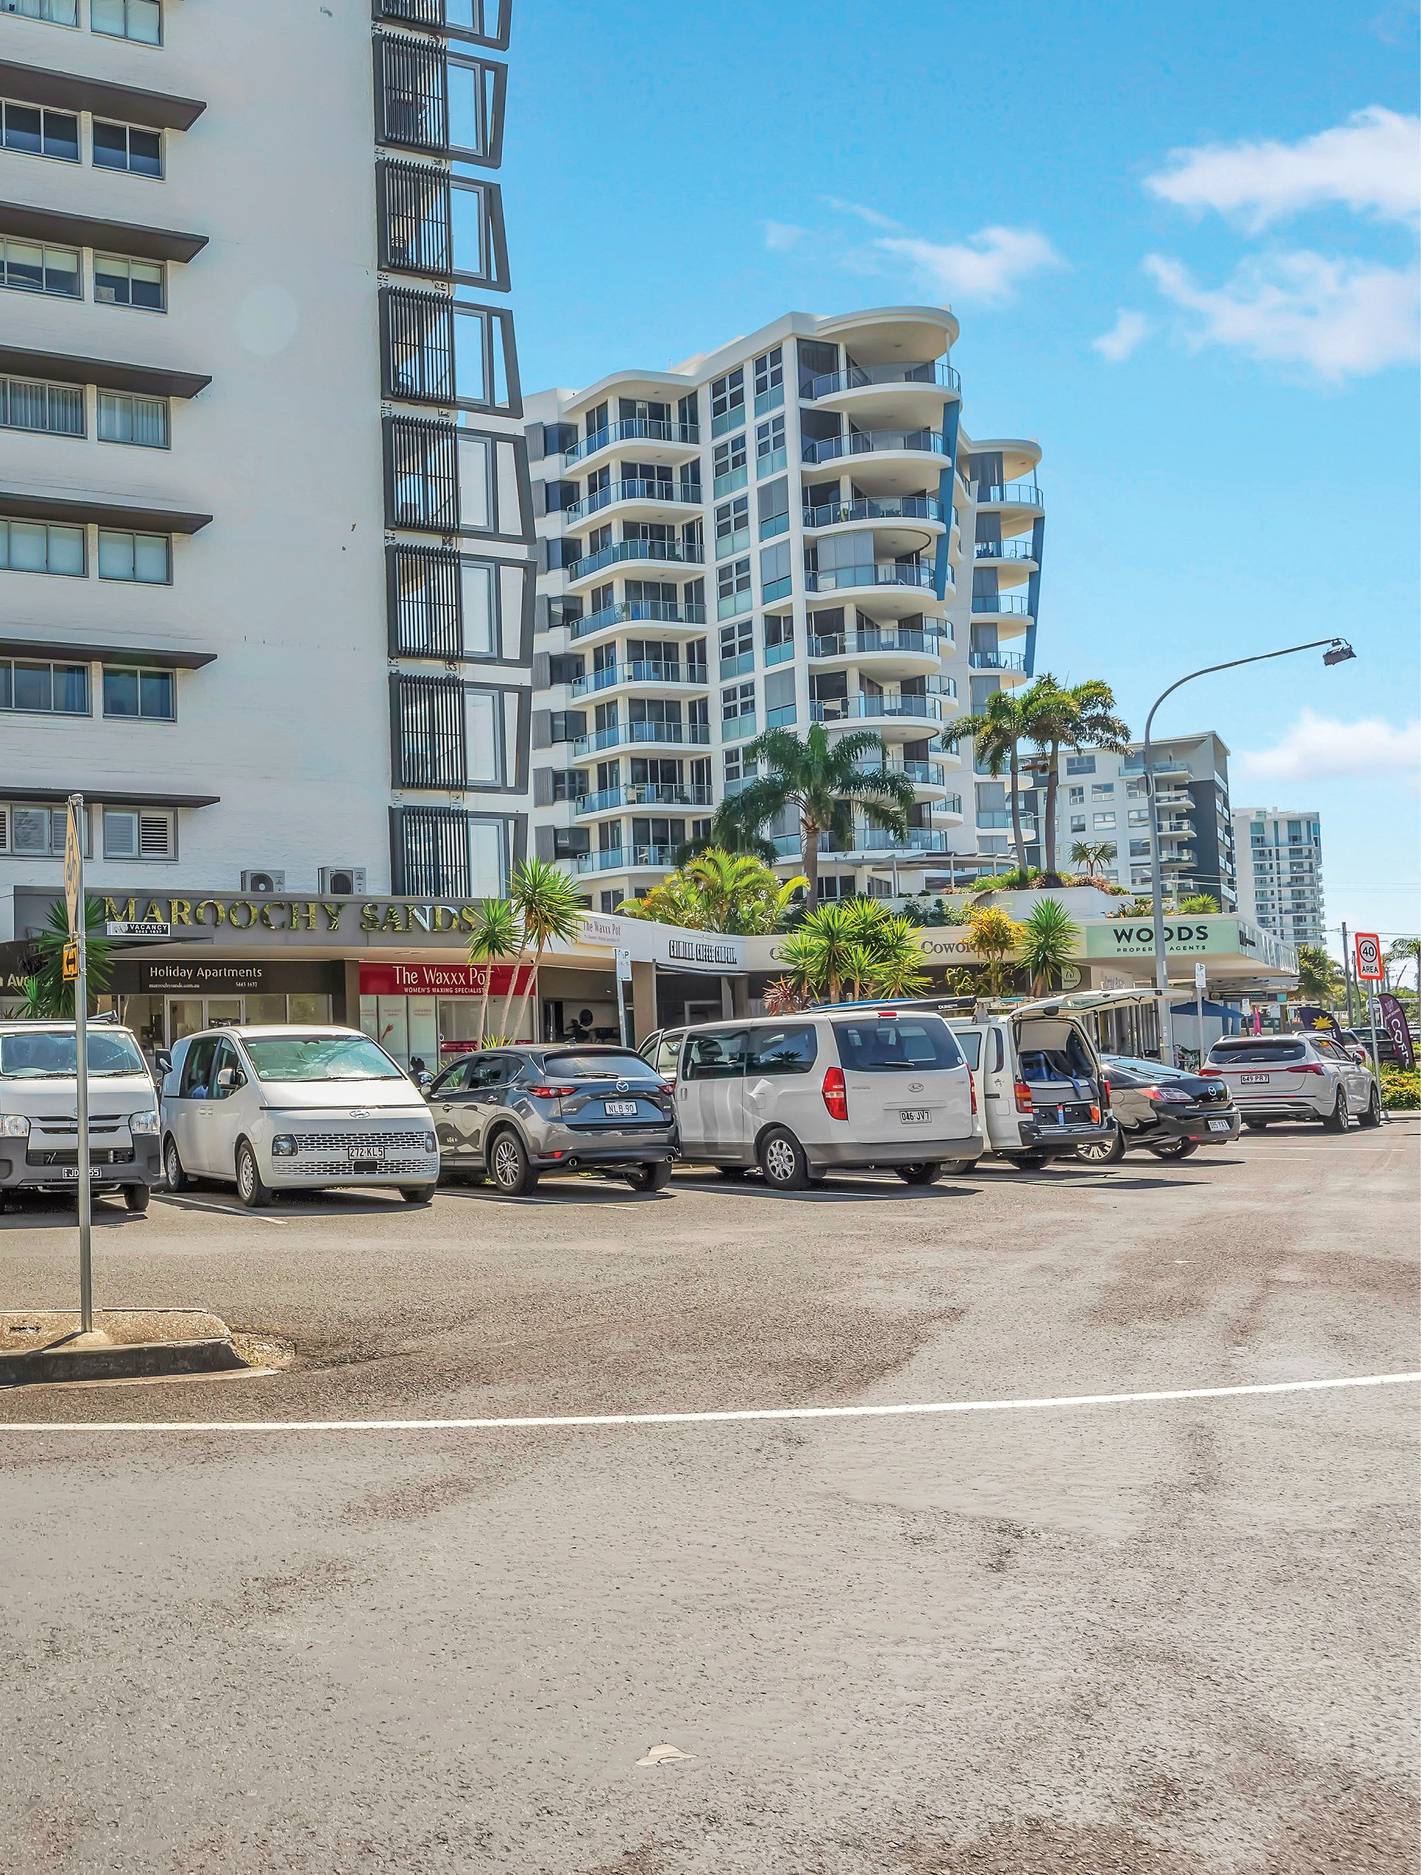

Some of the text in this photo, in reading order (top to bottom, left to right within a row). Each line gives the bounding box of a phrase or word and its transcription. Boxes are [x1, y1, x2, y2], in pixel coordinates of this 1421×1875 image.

[102, 897, 478, 933] MAROOCHY SANDS
[1113, 925, 1209, 944] WOODS
[1362, 946, 1375, 957] 40
[150, 966, 262, 980] Holiday Apartments
[392, 966, 418, 984] The
[423, 967, 466, 985] Waxxx
